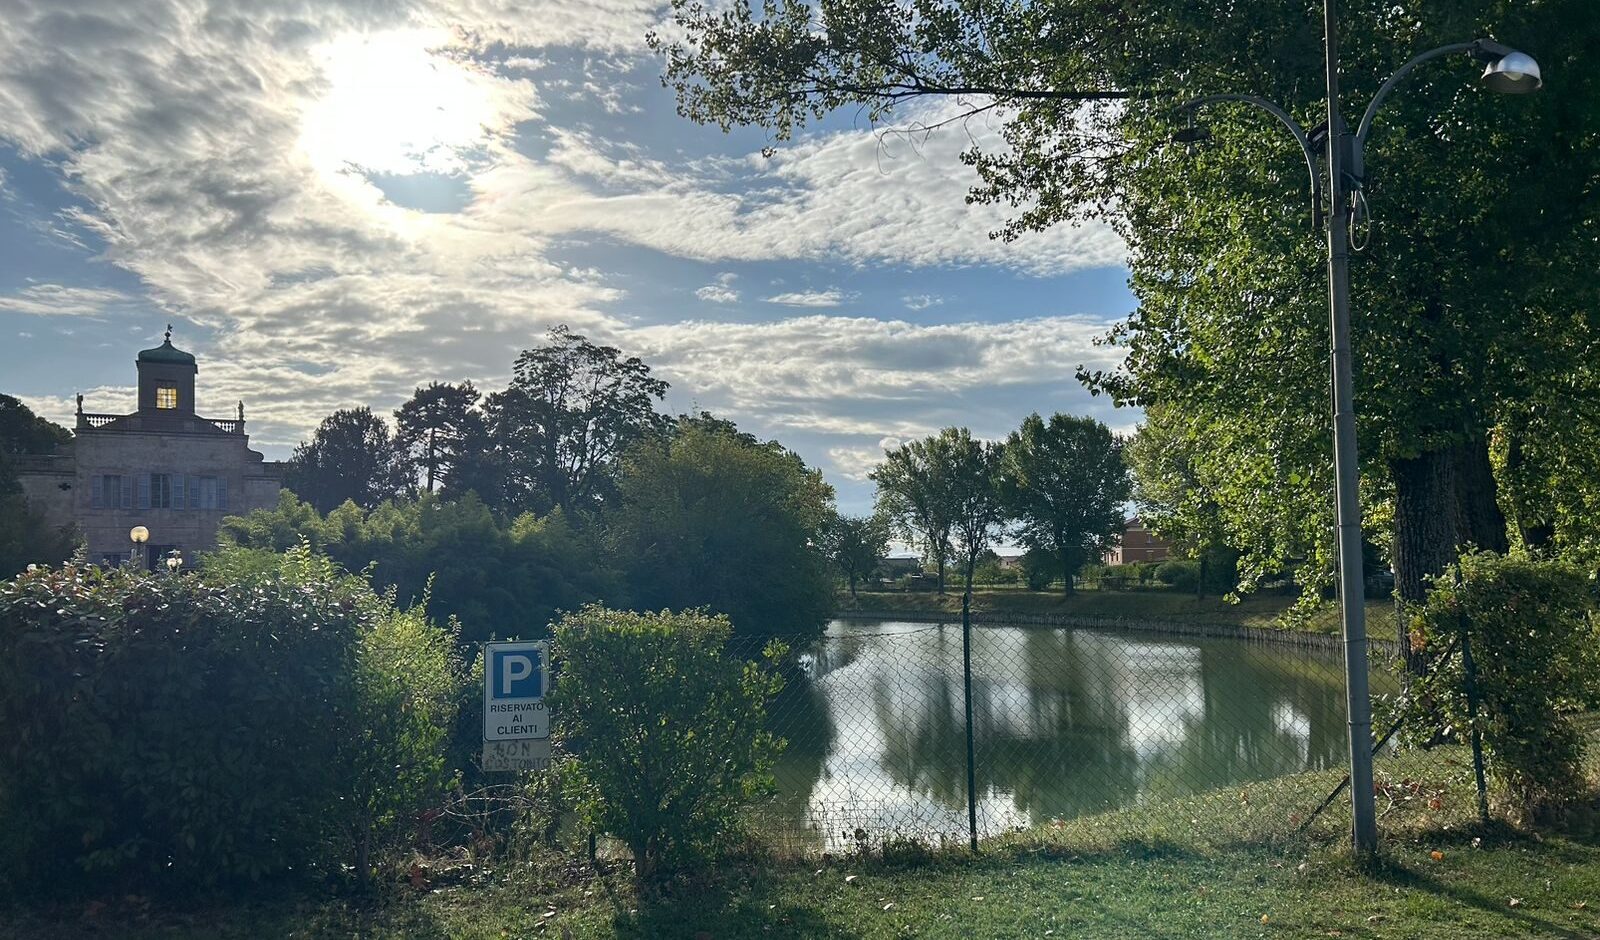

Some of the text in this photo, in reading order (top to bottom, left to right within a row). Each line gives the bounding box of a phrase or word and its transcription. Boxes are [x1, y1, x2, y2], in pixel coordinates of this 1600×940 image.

[502, 654, 532, 694] P
[490, 702, 544, 713] RISERVATO
[512, 714, 522, 723] AI
[497, 725, 537, 735] CLIENTI
